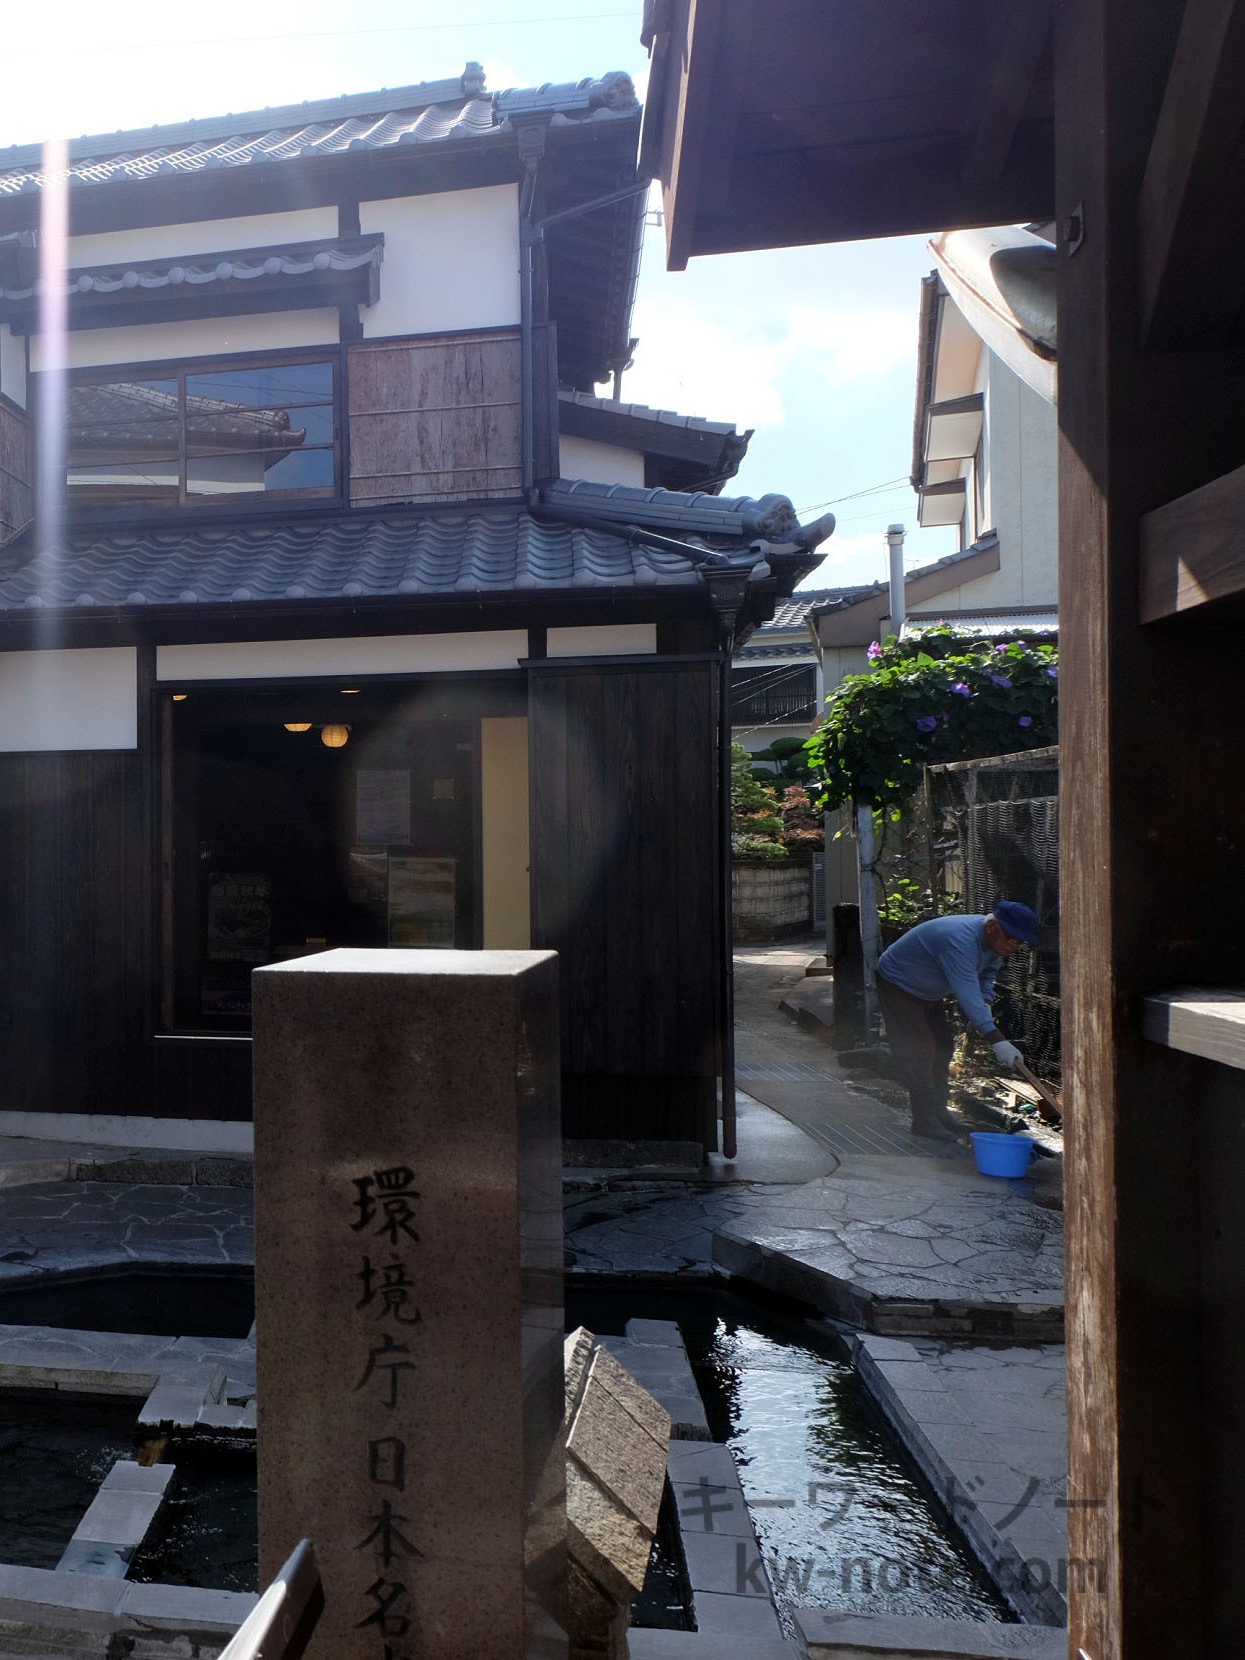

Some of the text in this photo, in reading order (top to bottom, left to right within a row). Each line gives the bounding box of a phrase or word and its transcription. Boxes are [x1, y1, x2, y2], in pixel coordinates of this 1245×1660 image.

[350, 1166, 425, 1660] 環境庁日本名
